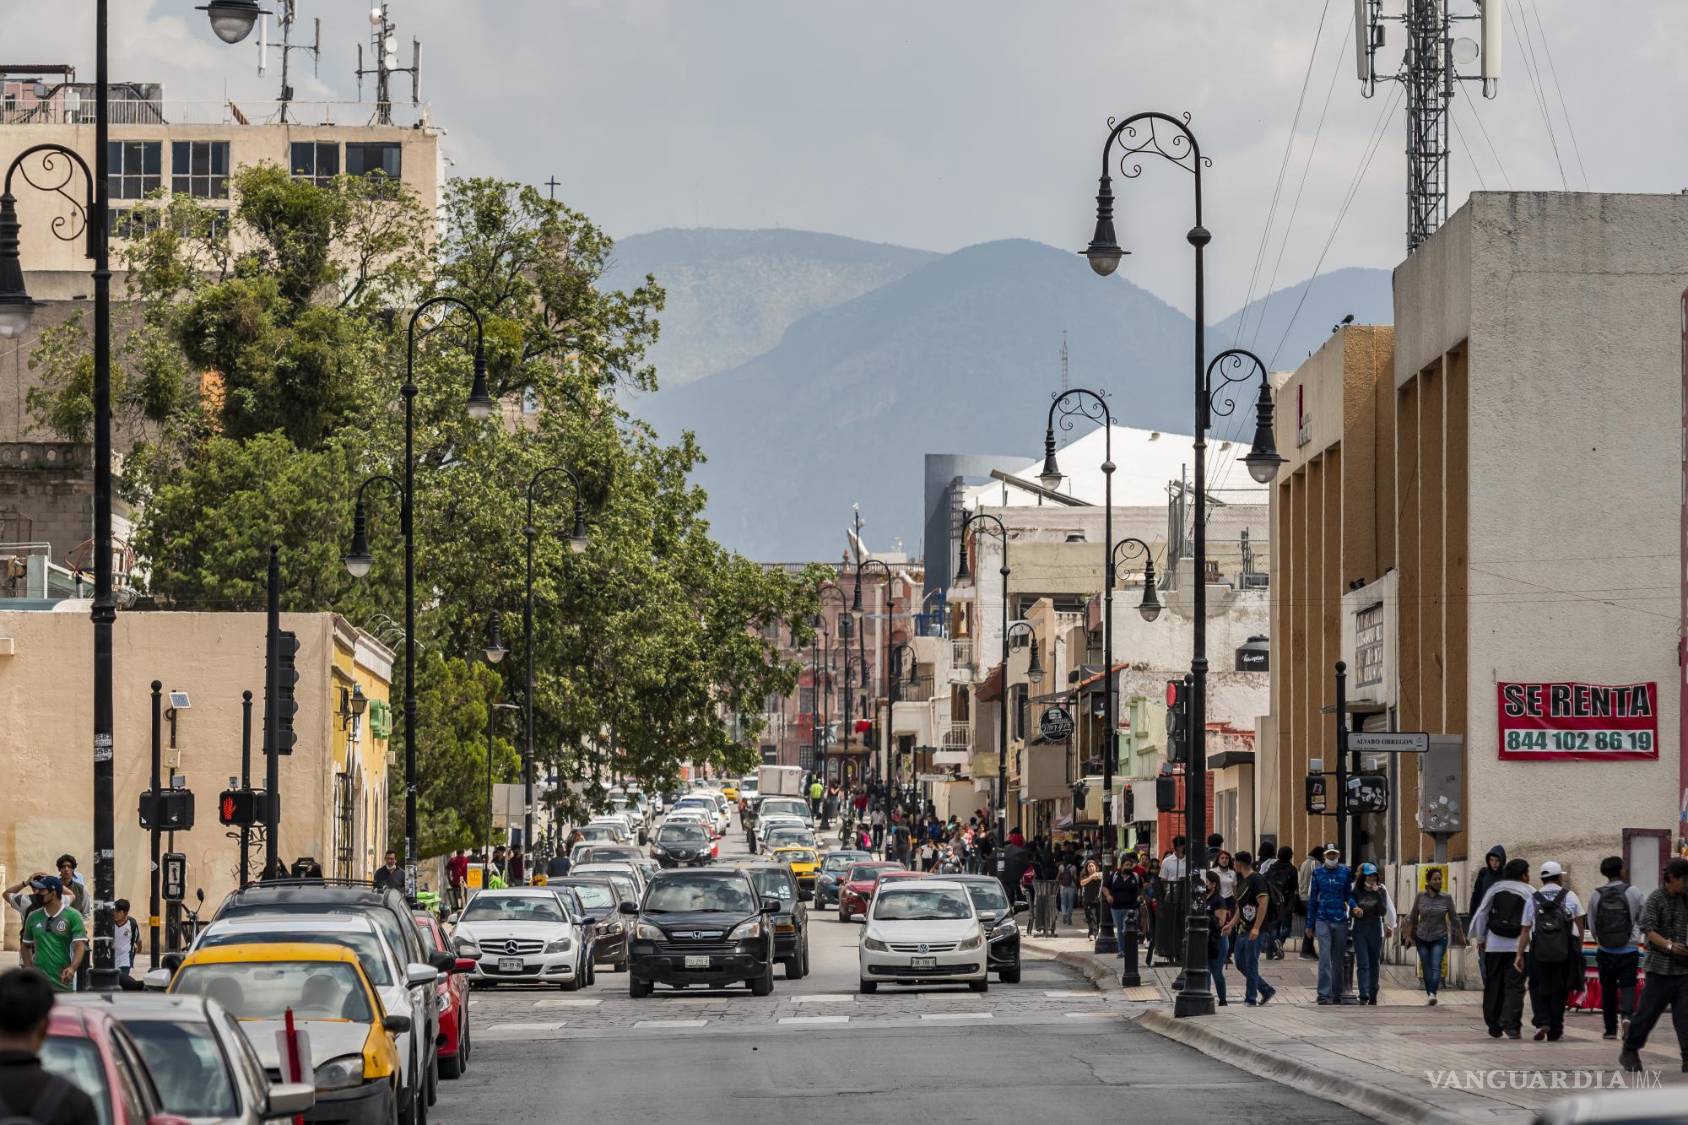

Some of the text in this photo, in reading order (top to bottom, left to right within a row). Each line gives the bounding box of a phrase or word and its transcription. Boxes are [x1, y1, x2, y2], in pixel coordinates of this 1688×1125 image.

[1504, 684, 1652, 717] SE RENTA
[1507, 731, 1651, 750] 844 102 86 19
